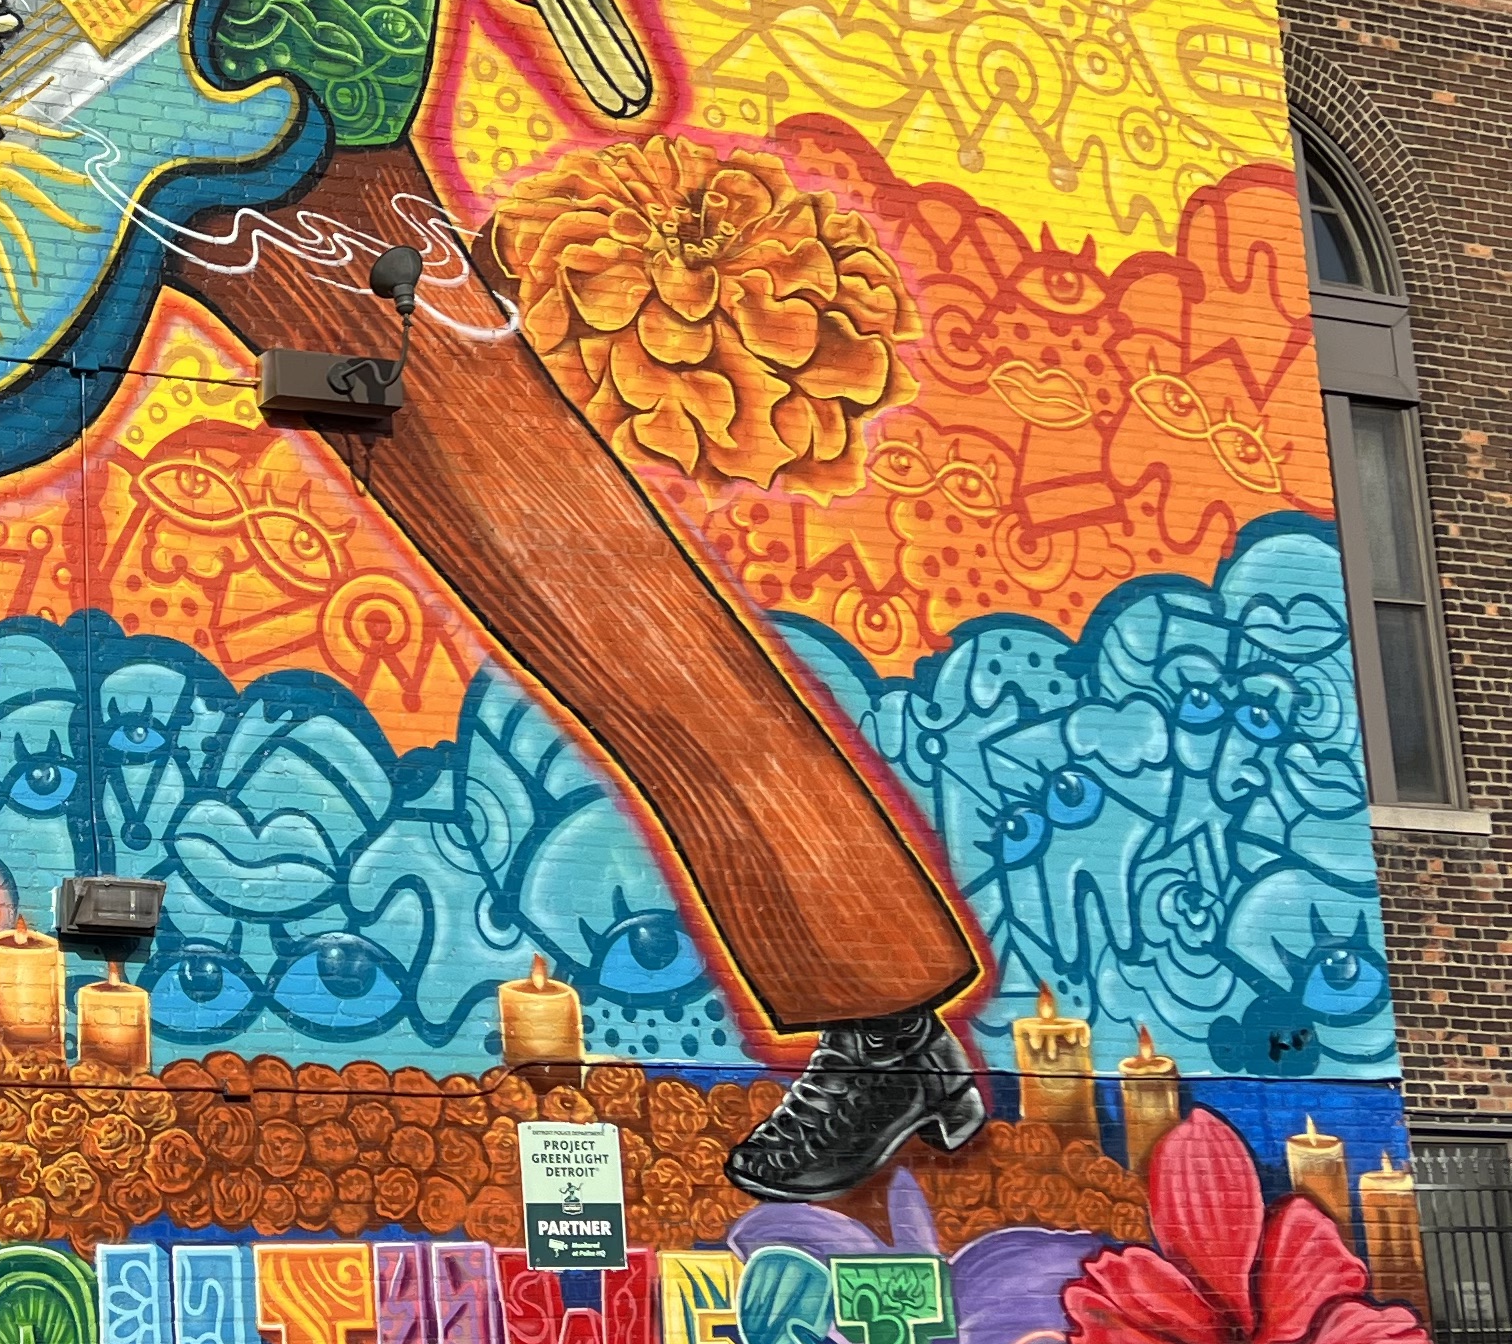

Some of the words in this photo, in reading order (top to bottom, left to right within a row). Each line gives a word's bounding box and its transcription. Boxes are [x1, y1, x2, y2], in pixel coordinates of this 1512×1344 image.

[544, 1140, 595, 1153] PROJECT
[531, 1153, 571, 1164] GREEN
[575, 1154, 609, 1165] LIGHT
[537, 1220, 612, 1236] PARTNER
